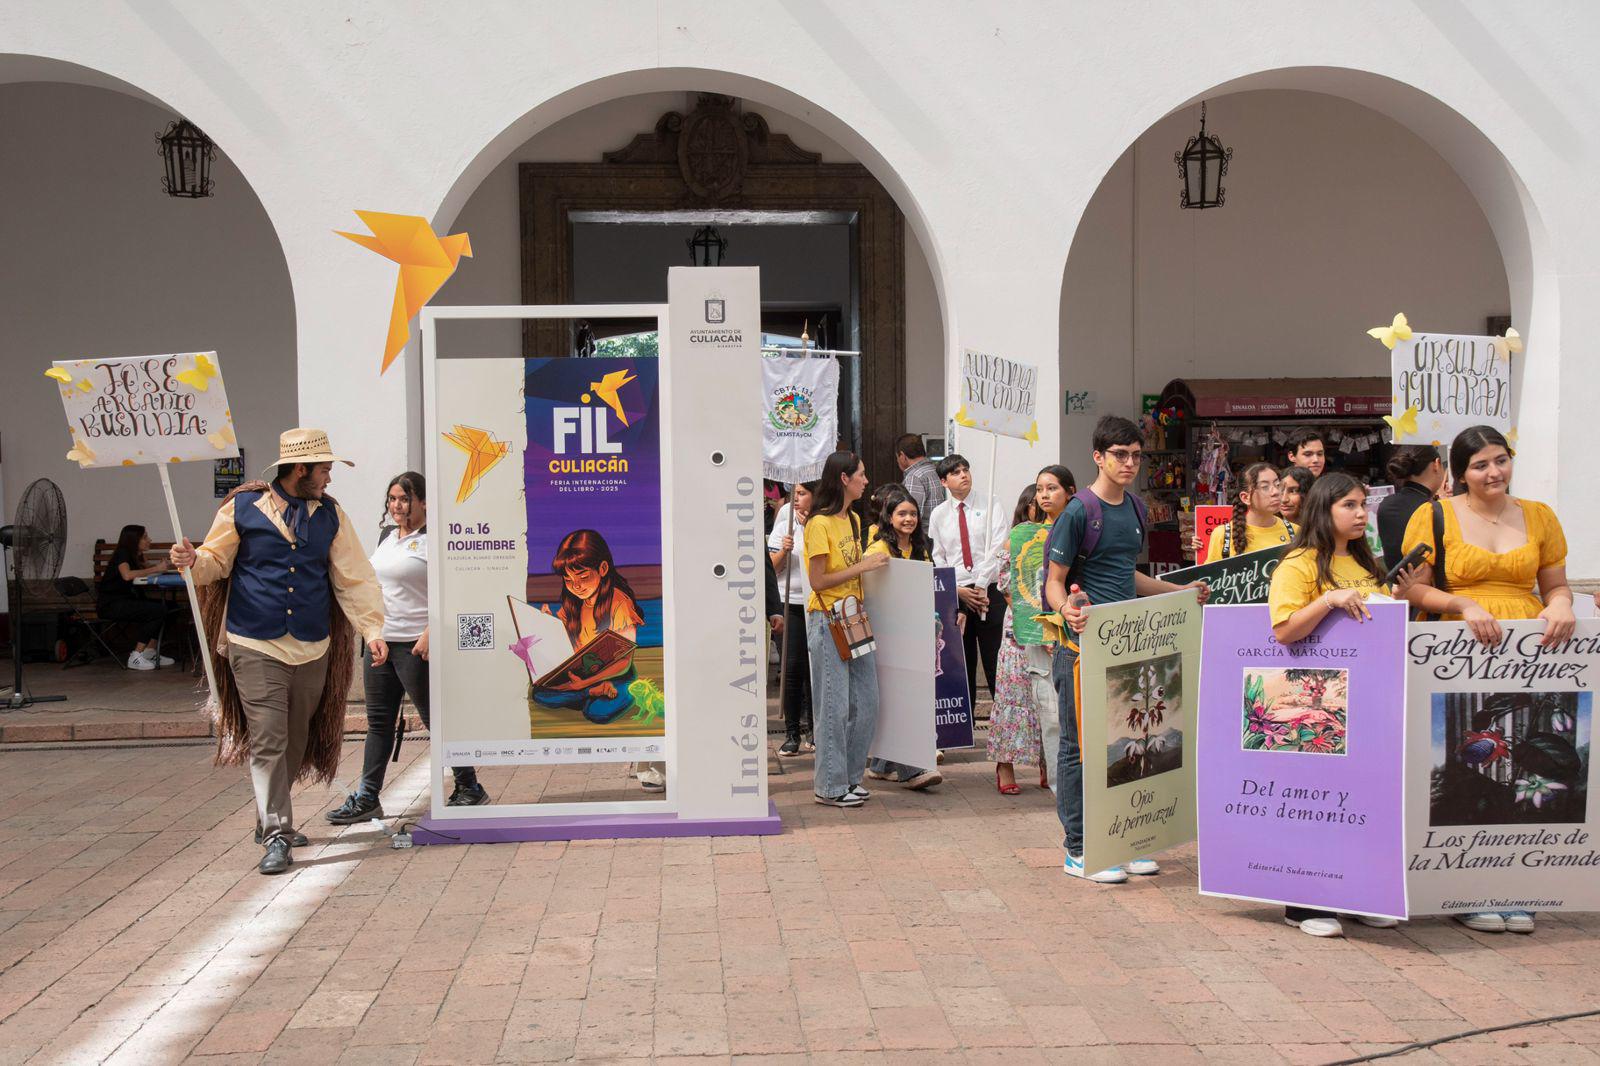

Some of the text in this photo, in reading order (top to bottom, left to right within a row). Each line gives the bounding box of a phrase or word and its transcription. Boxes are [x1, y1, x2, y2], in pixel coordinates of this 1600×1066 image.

[1414, 335, 1499, 377] ÚRSULA
[94, 354, 178, 395] JOSÉ
[773, 385, 797, 396] CBTA
[92, 392, 196, 414] ARCADIO
[1294, 397, 1337, 408] MUJER
[1294, 407, 1337, 415] PRODUCTIVA
[449, 523, 490, 535] 10 AL 16
[447, 540, 516, 551] NOVIEMBRE
[726, 475, 760, 798] Inés Arredondo
[1098, 610, 1149, 646] Gabriel
[1111, 631, 1178, 656] Márquez
[1268, 635, 1322, 644] GIEL
[1237, 646, 1358, 658] GARCÍA MÁRQUEZ
[1434, 655, 1588, 688] Márquez
[1131, 789, 1155, 813] Ojos
[1240, 779, 1349, 807] Del amor y
[1108, 797, 1178, 838] de perro azul
[1225, 802, 1367, 826] otros demonios
[1422, 829, 1589, 851] Los funerales de
[1248, 861, 1344, 880] Editorial Sudamericana
[1408, 850, 1600, 871] la Mamá Grande
[1441, 898, 1564, 909] Editorial Sudamericana
